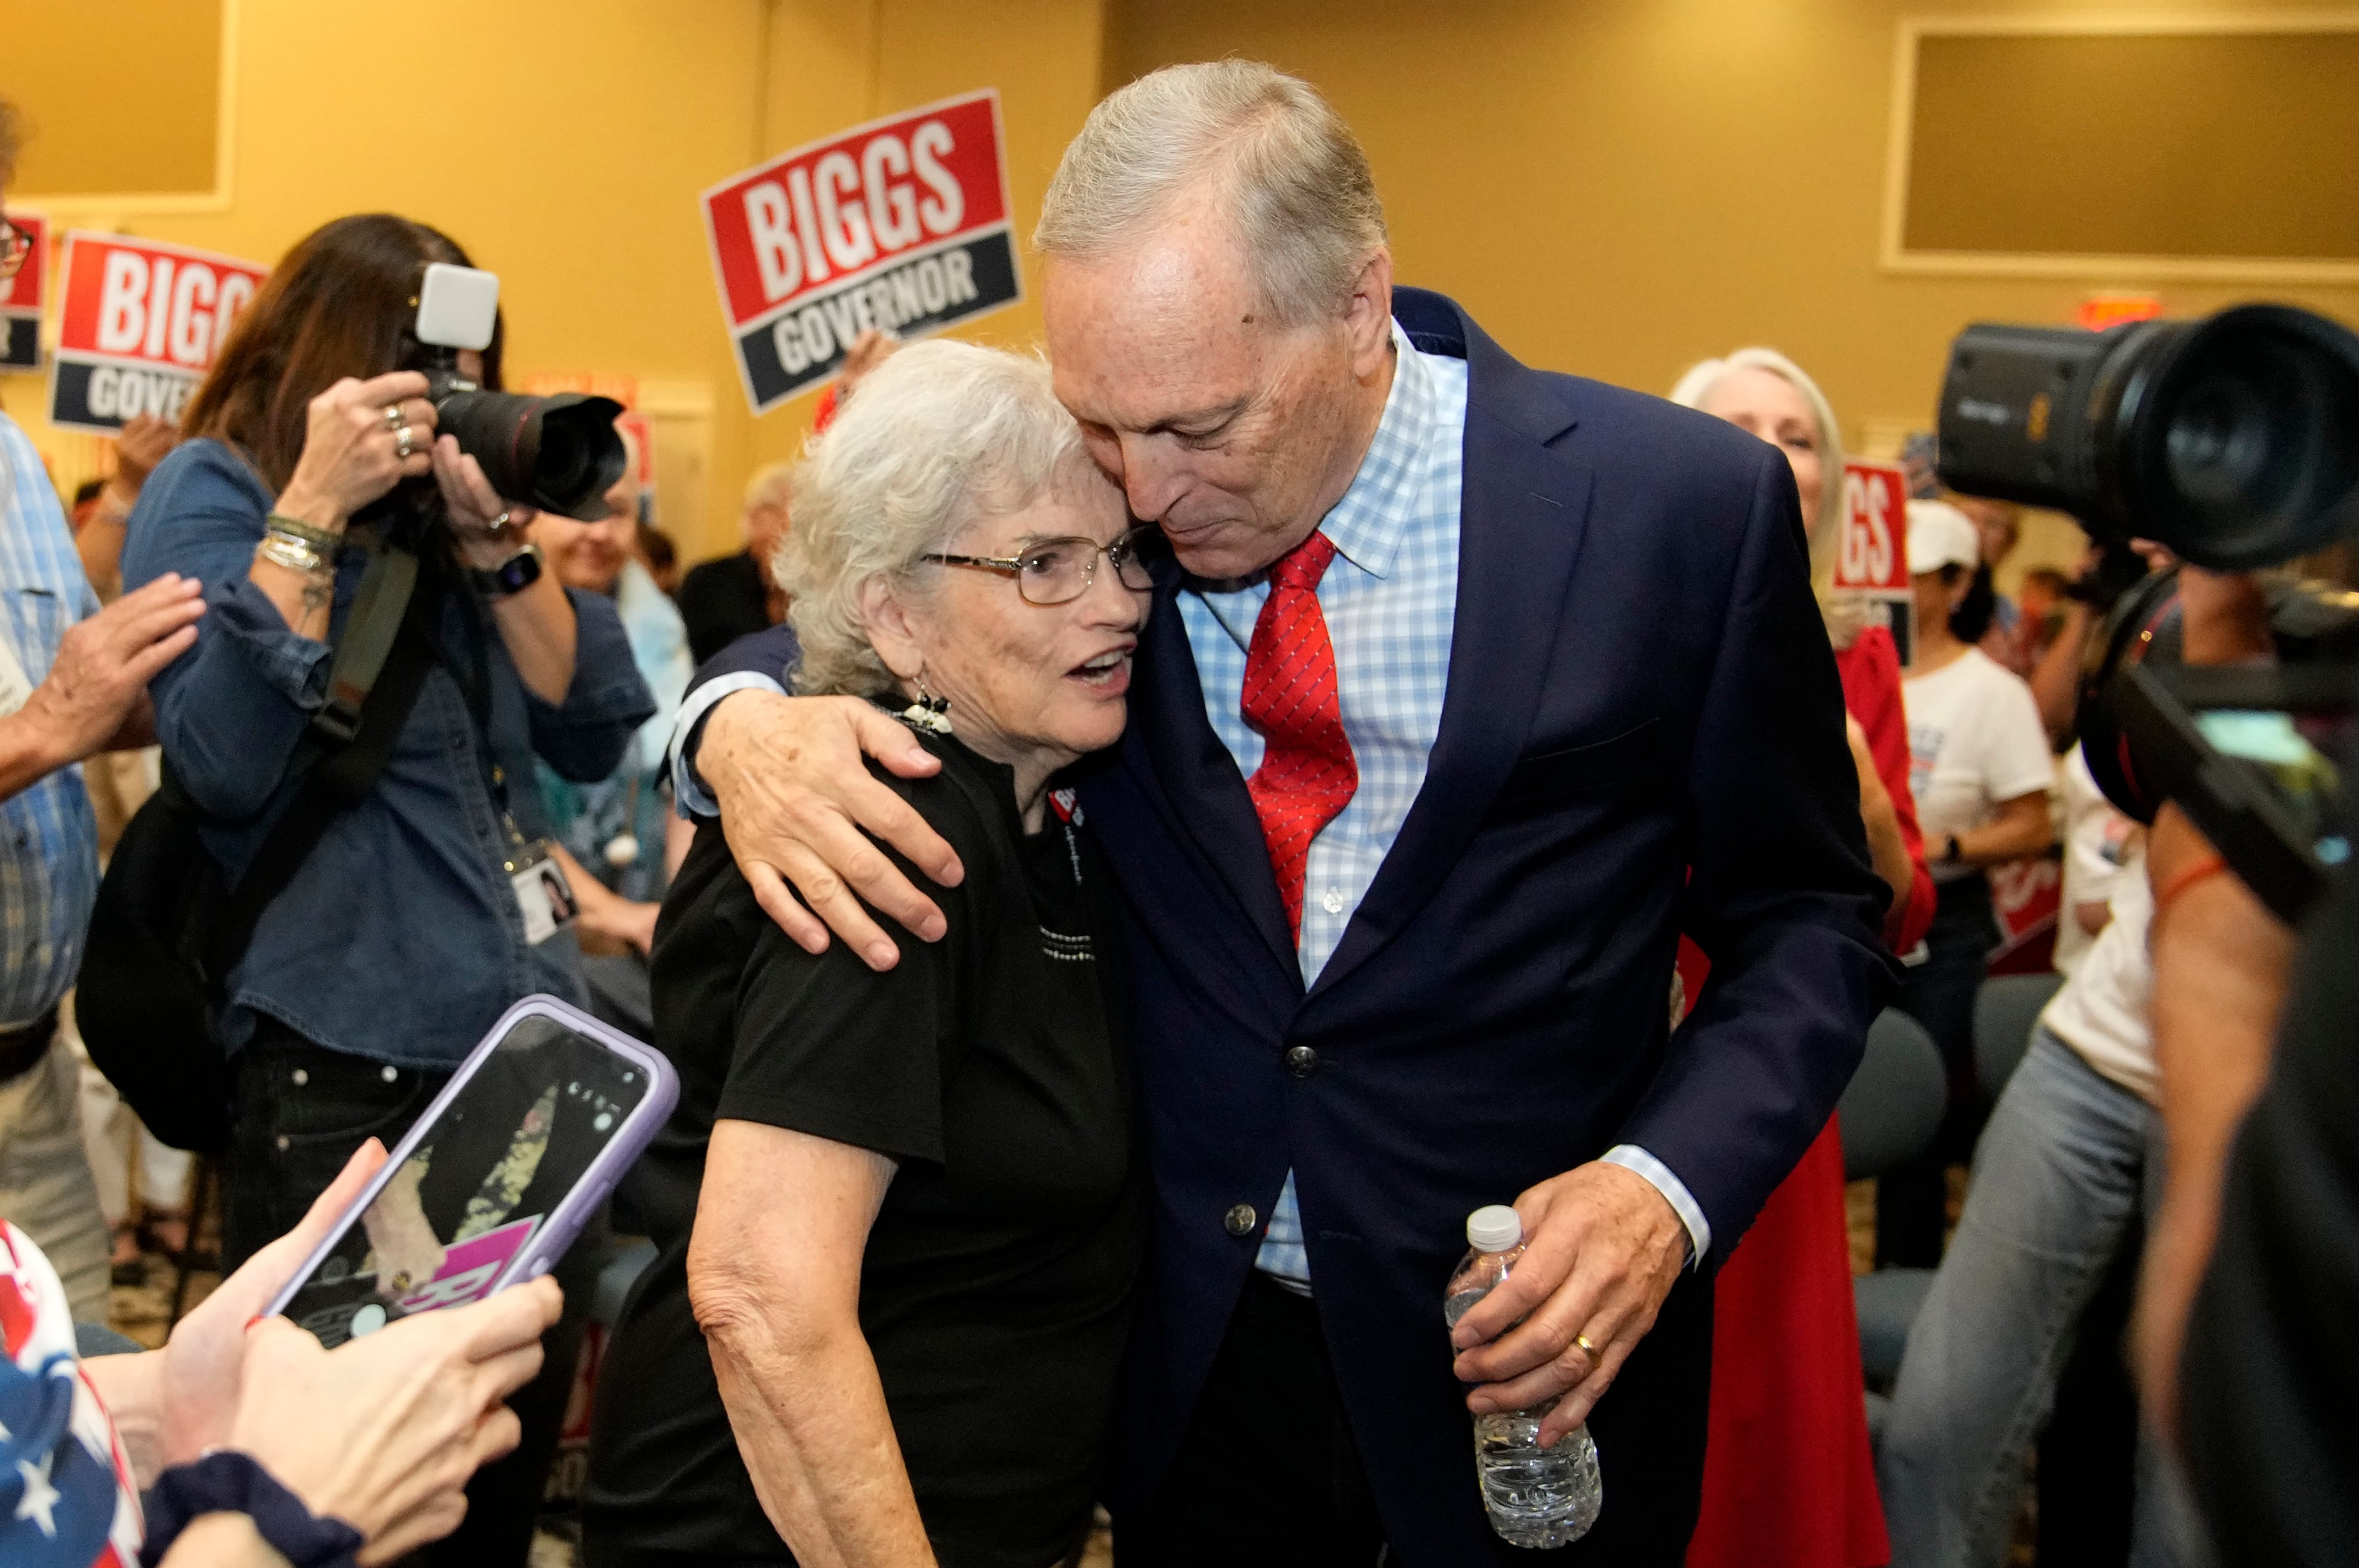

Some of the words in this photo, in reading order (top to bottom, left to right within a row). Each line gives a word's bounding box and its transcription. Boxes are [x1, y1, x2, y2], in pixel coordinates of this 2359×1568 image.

[745, 121, 964, 302] BIGGS
[100, 251, 255, 363] BIGG
[773, 248, 978, 375] GOVERNOR
